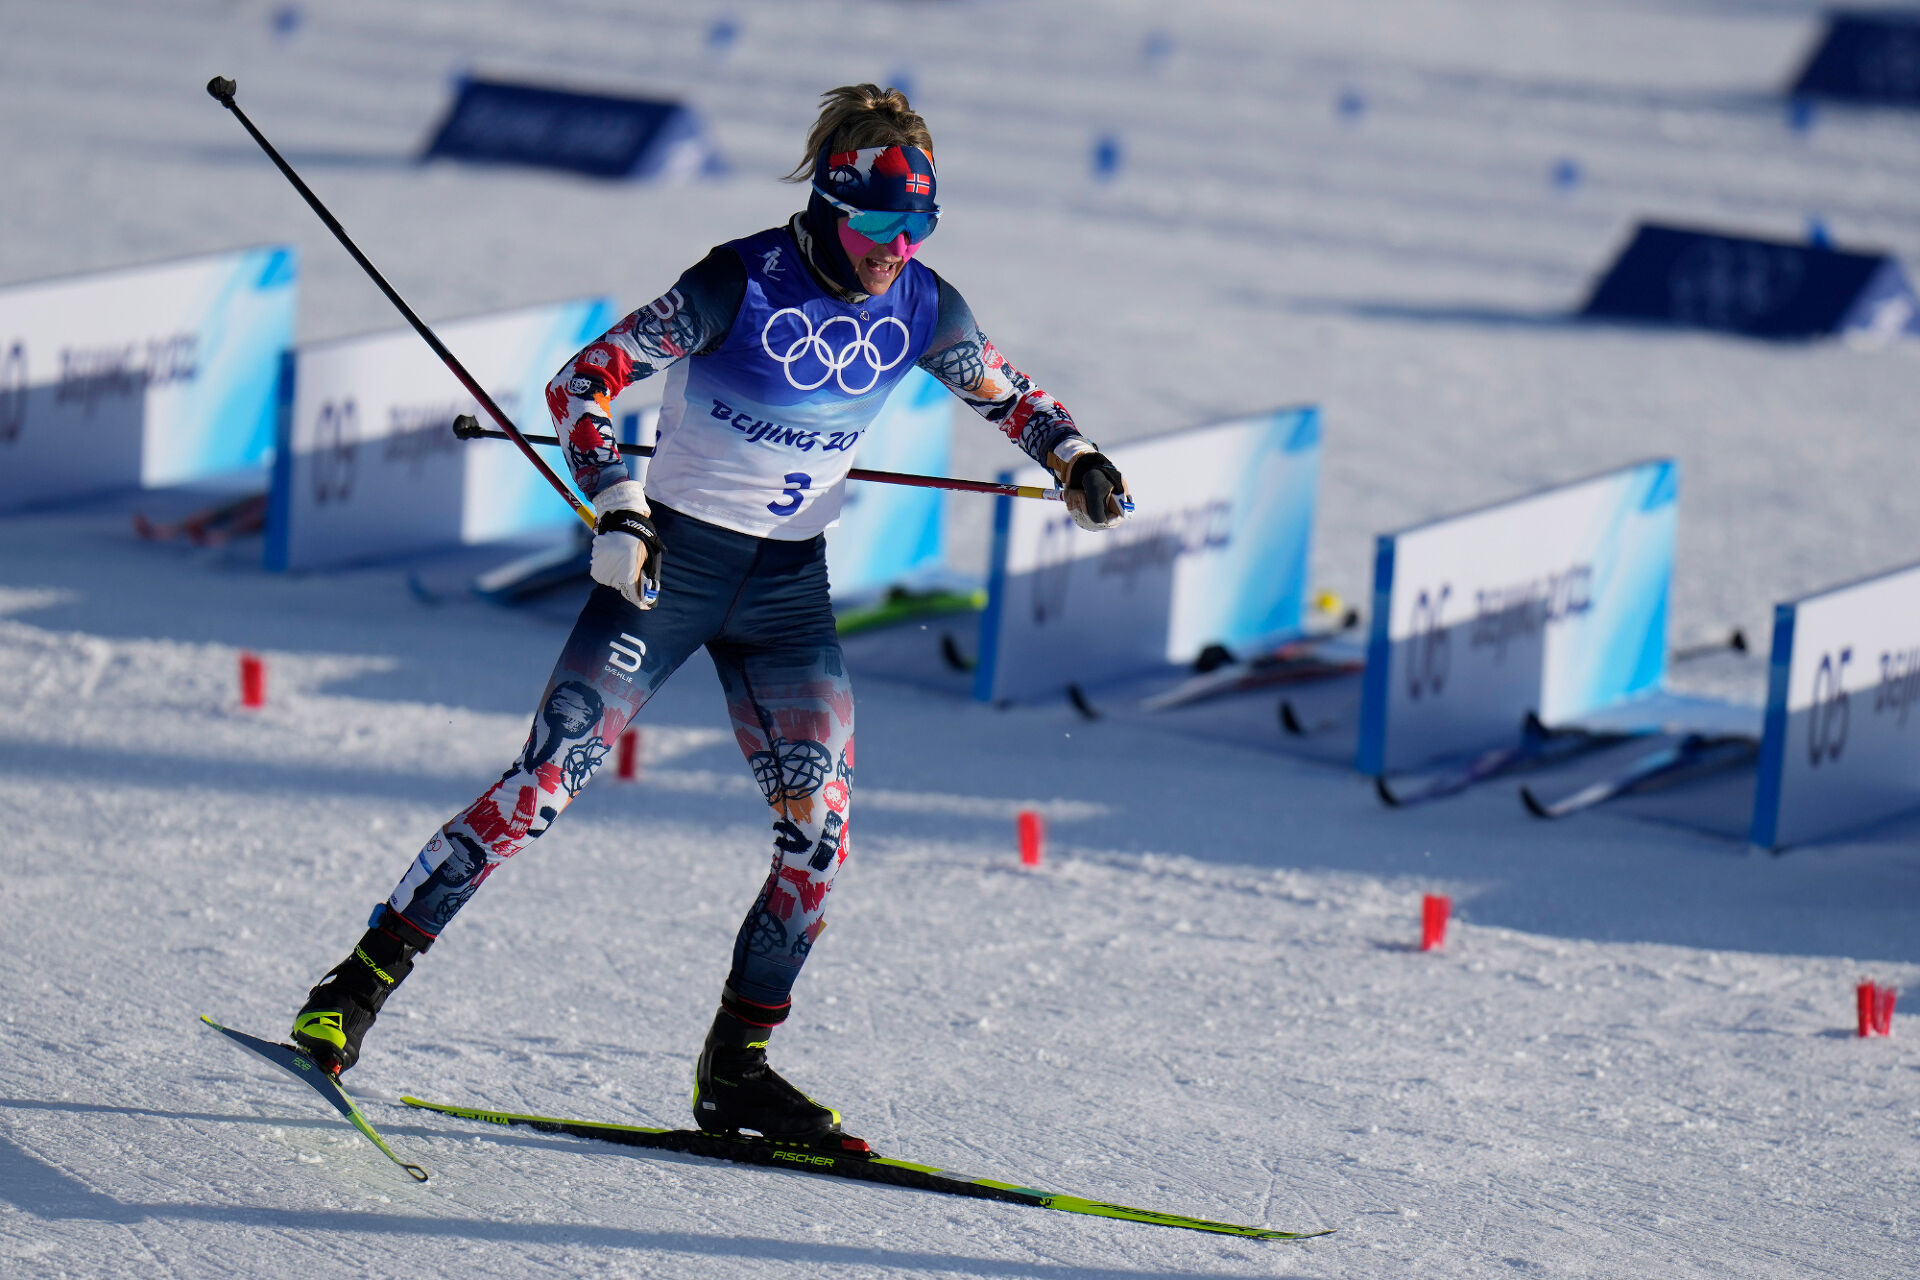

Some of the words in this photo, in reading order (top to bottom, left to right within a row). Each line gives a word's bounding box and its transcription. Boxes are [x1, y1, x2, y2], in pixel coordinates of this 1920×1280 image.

[710, 399, 821, 452] BEIJING
[766, 472, 812, 517] 3
[1808, 648, 1852, 768] 05
[772, 1150, 835, 1167] FISCHER
